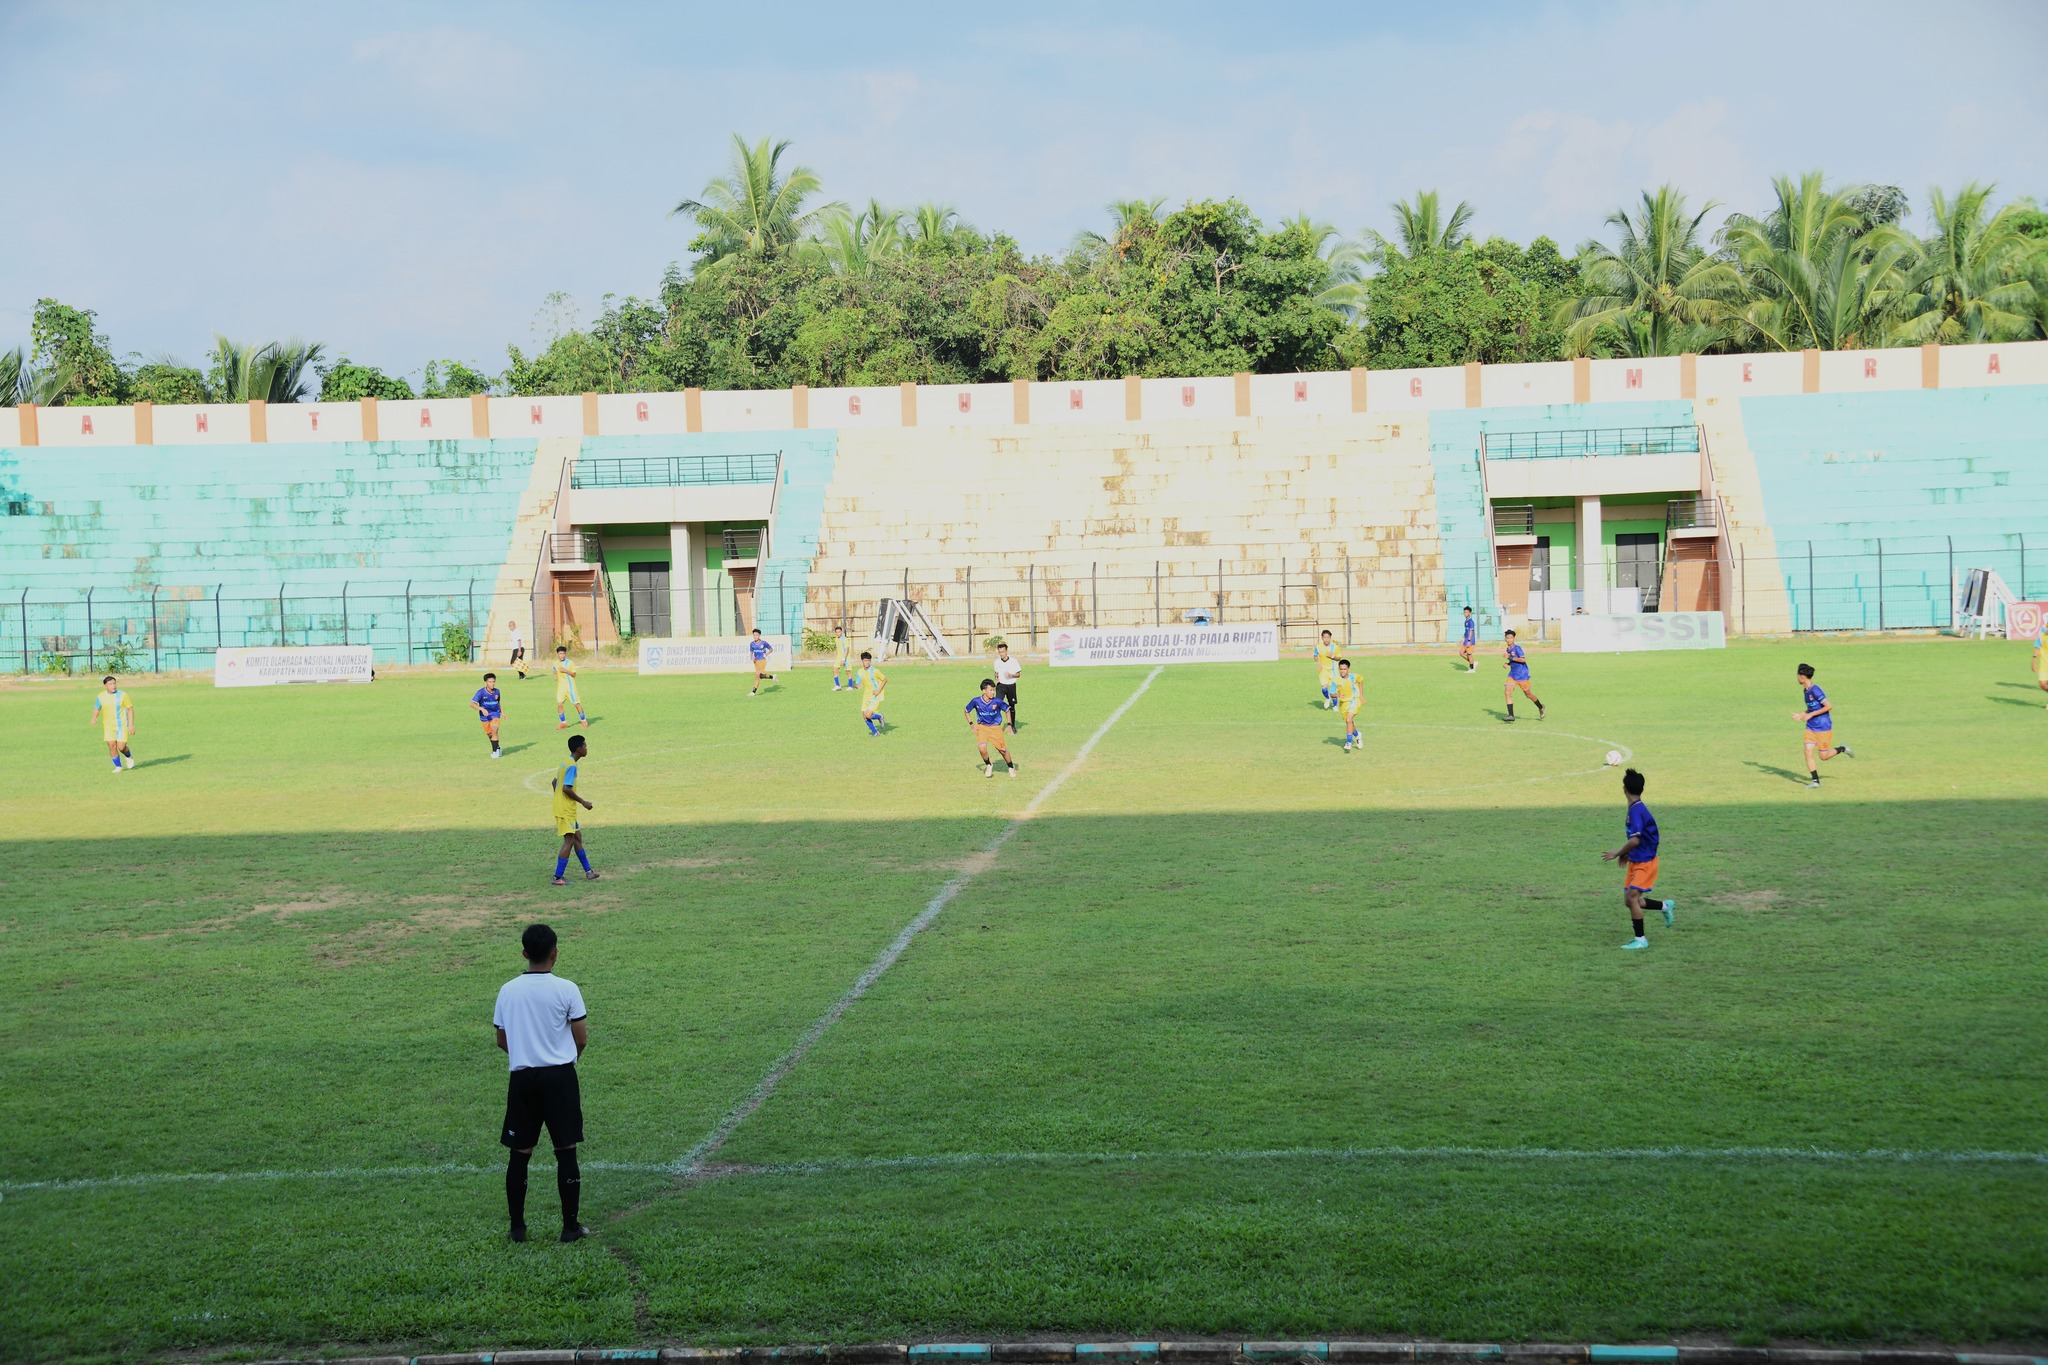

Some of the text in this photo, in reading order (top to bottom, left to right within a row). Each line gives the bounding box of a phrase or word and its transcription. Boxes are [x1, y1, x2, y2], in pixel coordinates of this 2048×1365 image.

[1611, 614, 1710, 641] PSSI
[1078, 630, 1273, 649] LIGA SEPAK BOLA U-18 PIALA BUPATI
[1090, 649, 1115, 660] HULU
[1116, 648, 1153, 659] SUNGAI
[1153, 647, 1194, 658] SELATAN
[245, 656, 270, 667] KOMITE
[303, 655, 334, 666] NASIONAL
[334, 654, 368, 666] INDONESIA
[666, 656, 703, 666] KABUPATEN
[258, 666, 296, 677] KABUPATEN
[339, 665, 366, 675] SELATAN
